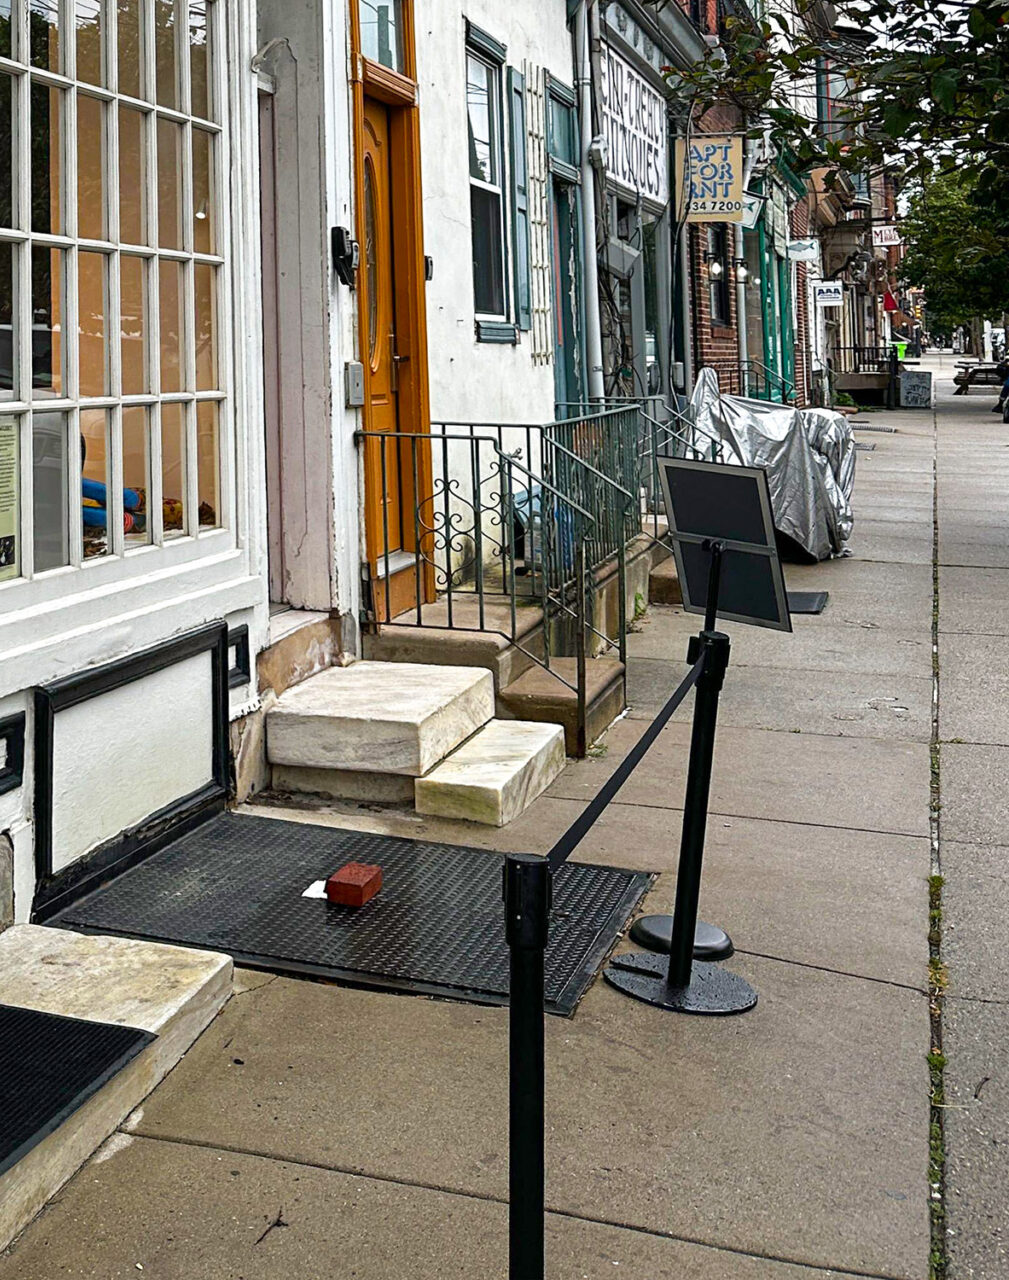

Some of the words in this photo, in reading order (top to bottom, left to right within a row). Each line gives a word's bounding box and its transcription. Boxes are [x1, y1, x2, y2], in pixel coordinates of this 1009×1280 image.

[600, 46, 664, 149] ENN-TREATY
[685, 144, 733, 162] APT
[685, 163, 734, 181] FOR
[711, 202, 742, 211] 7200
